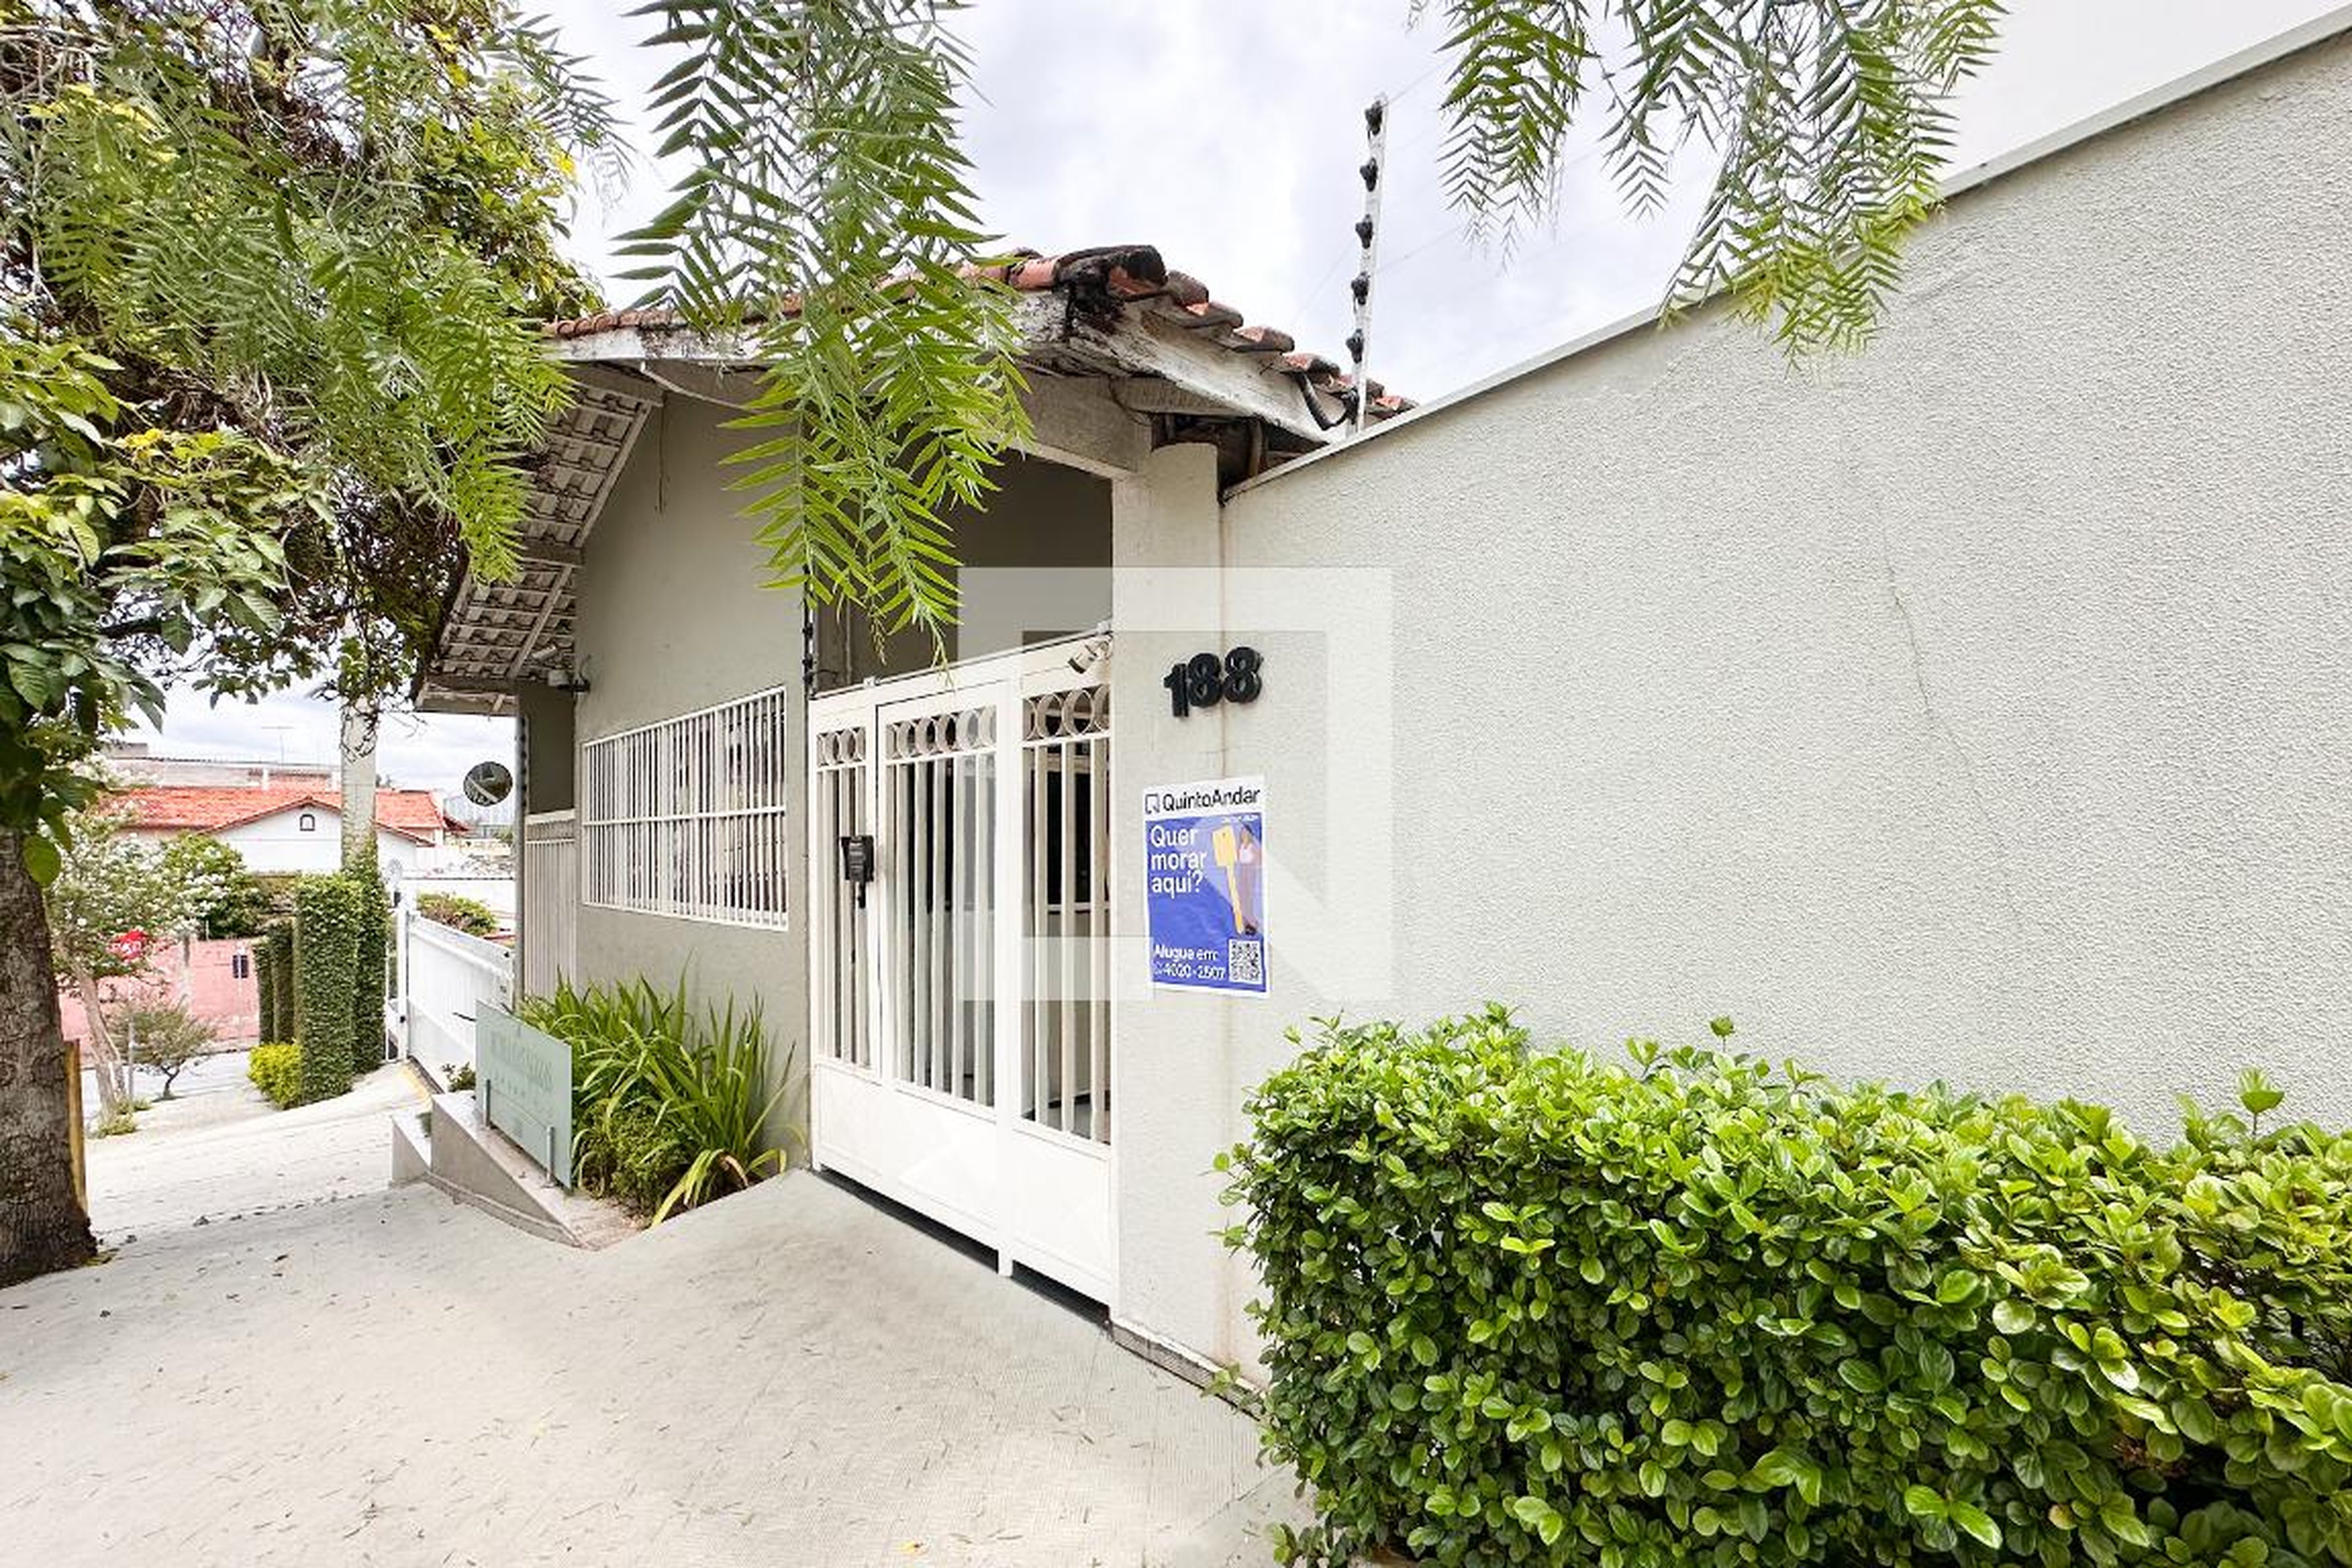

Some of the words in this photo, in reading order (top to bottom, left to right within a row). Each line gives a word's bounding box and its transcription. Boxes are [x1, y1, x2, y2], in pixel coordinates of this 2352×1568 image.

[1163, 646, 1263, 717] 188
[1163, 786, 1261, 812] QuintoAndar
[1151, 824, 1199, 848] Quer
[1152, 851, 1207, 870] morar
[1152, 870, 1203, 899] aqui?
